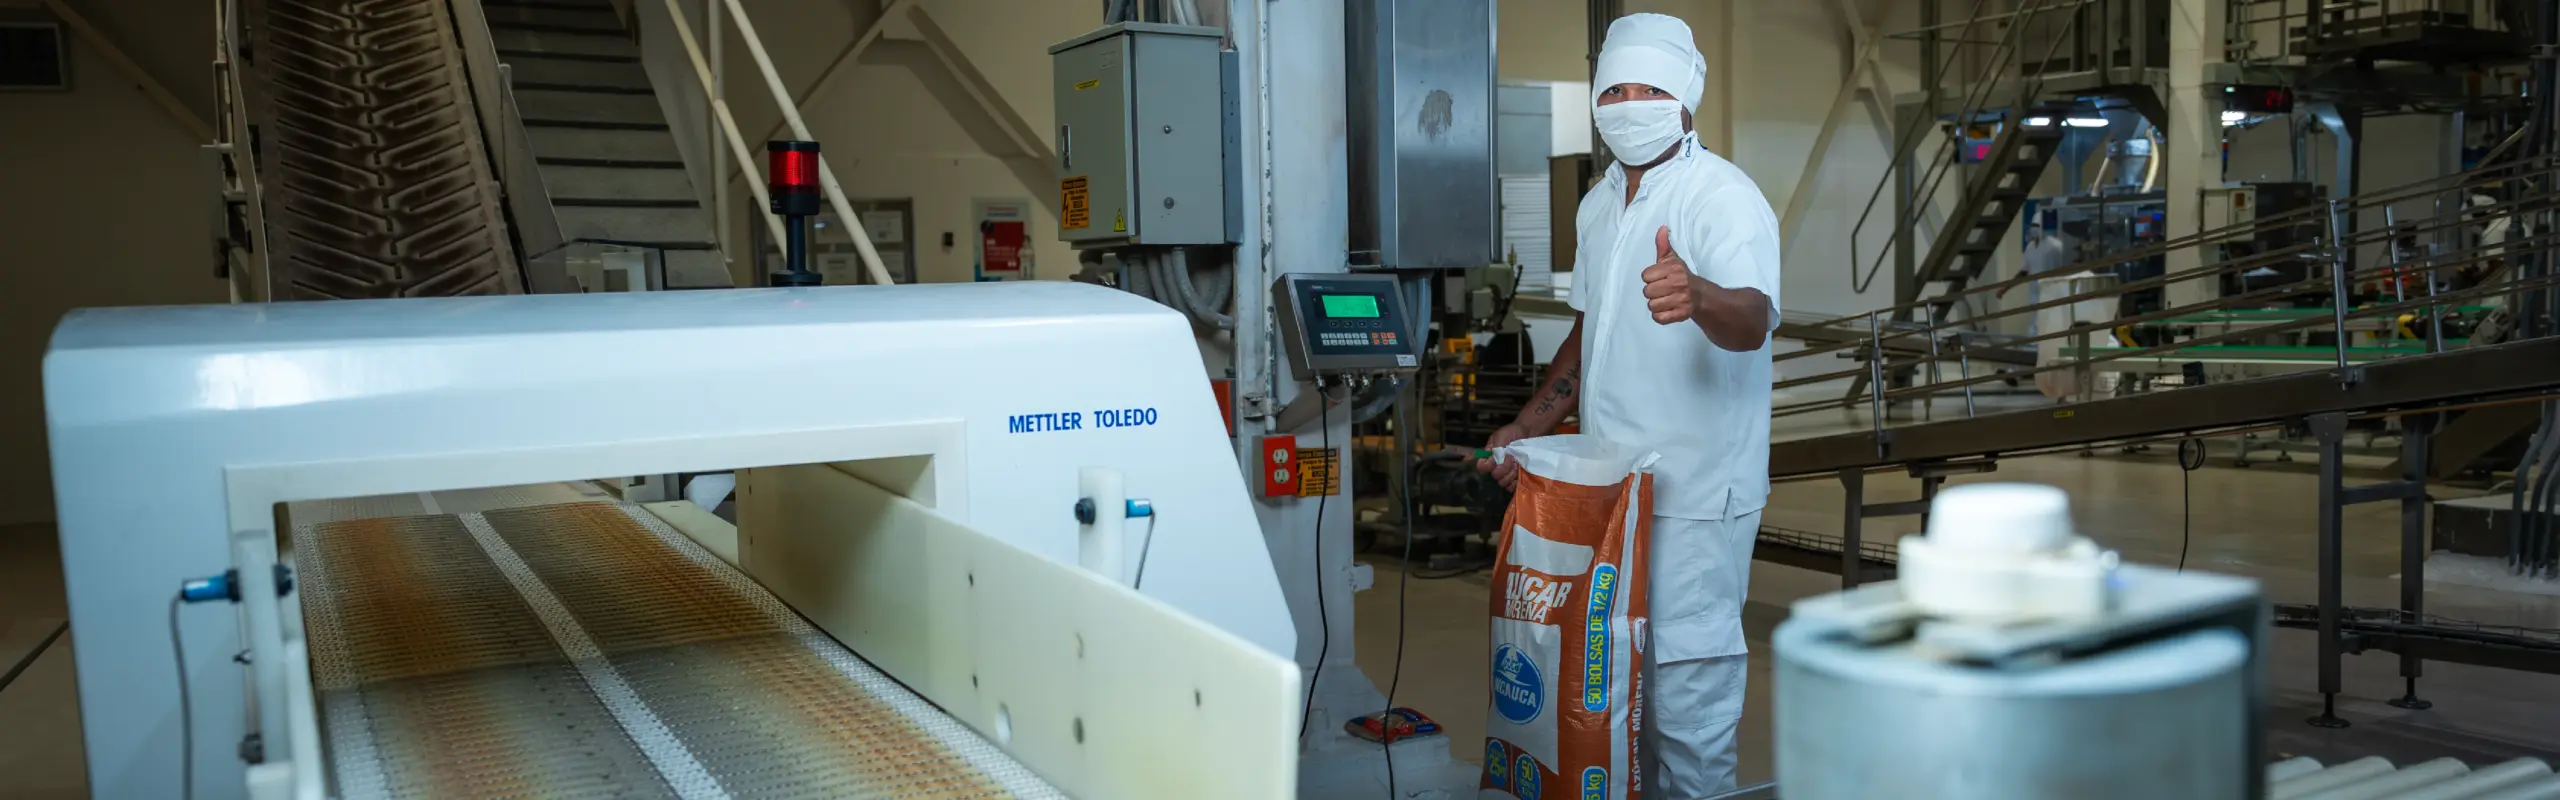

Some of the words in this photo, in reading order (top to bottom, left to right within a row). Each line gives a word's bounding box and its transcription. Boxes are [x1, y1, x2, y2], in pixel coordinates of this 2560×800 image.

[1009, 412, 1082, 433] METTLER
[1093, 407, 1158, 428] TOLEDO
[1594, 572, 1615, 590] kg
[1593, 591, 1609, 613] 1/2
[1590, 614, 1604, 632] DE
[1588, 633, 1604, 685] BOLSAS
[1493, 676, 1537, 709] NCAUCA
[1587, 687, 1602, 705] 50
[1521, 759, 1534, 782] 50
[1586, 773, 1604, 791] kg
